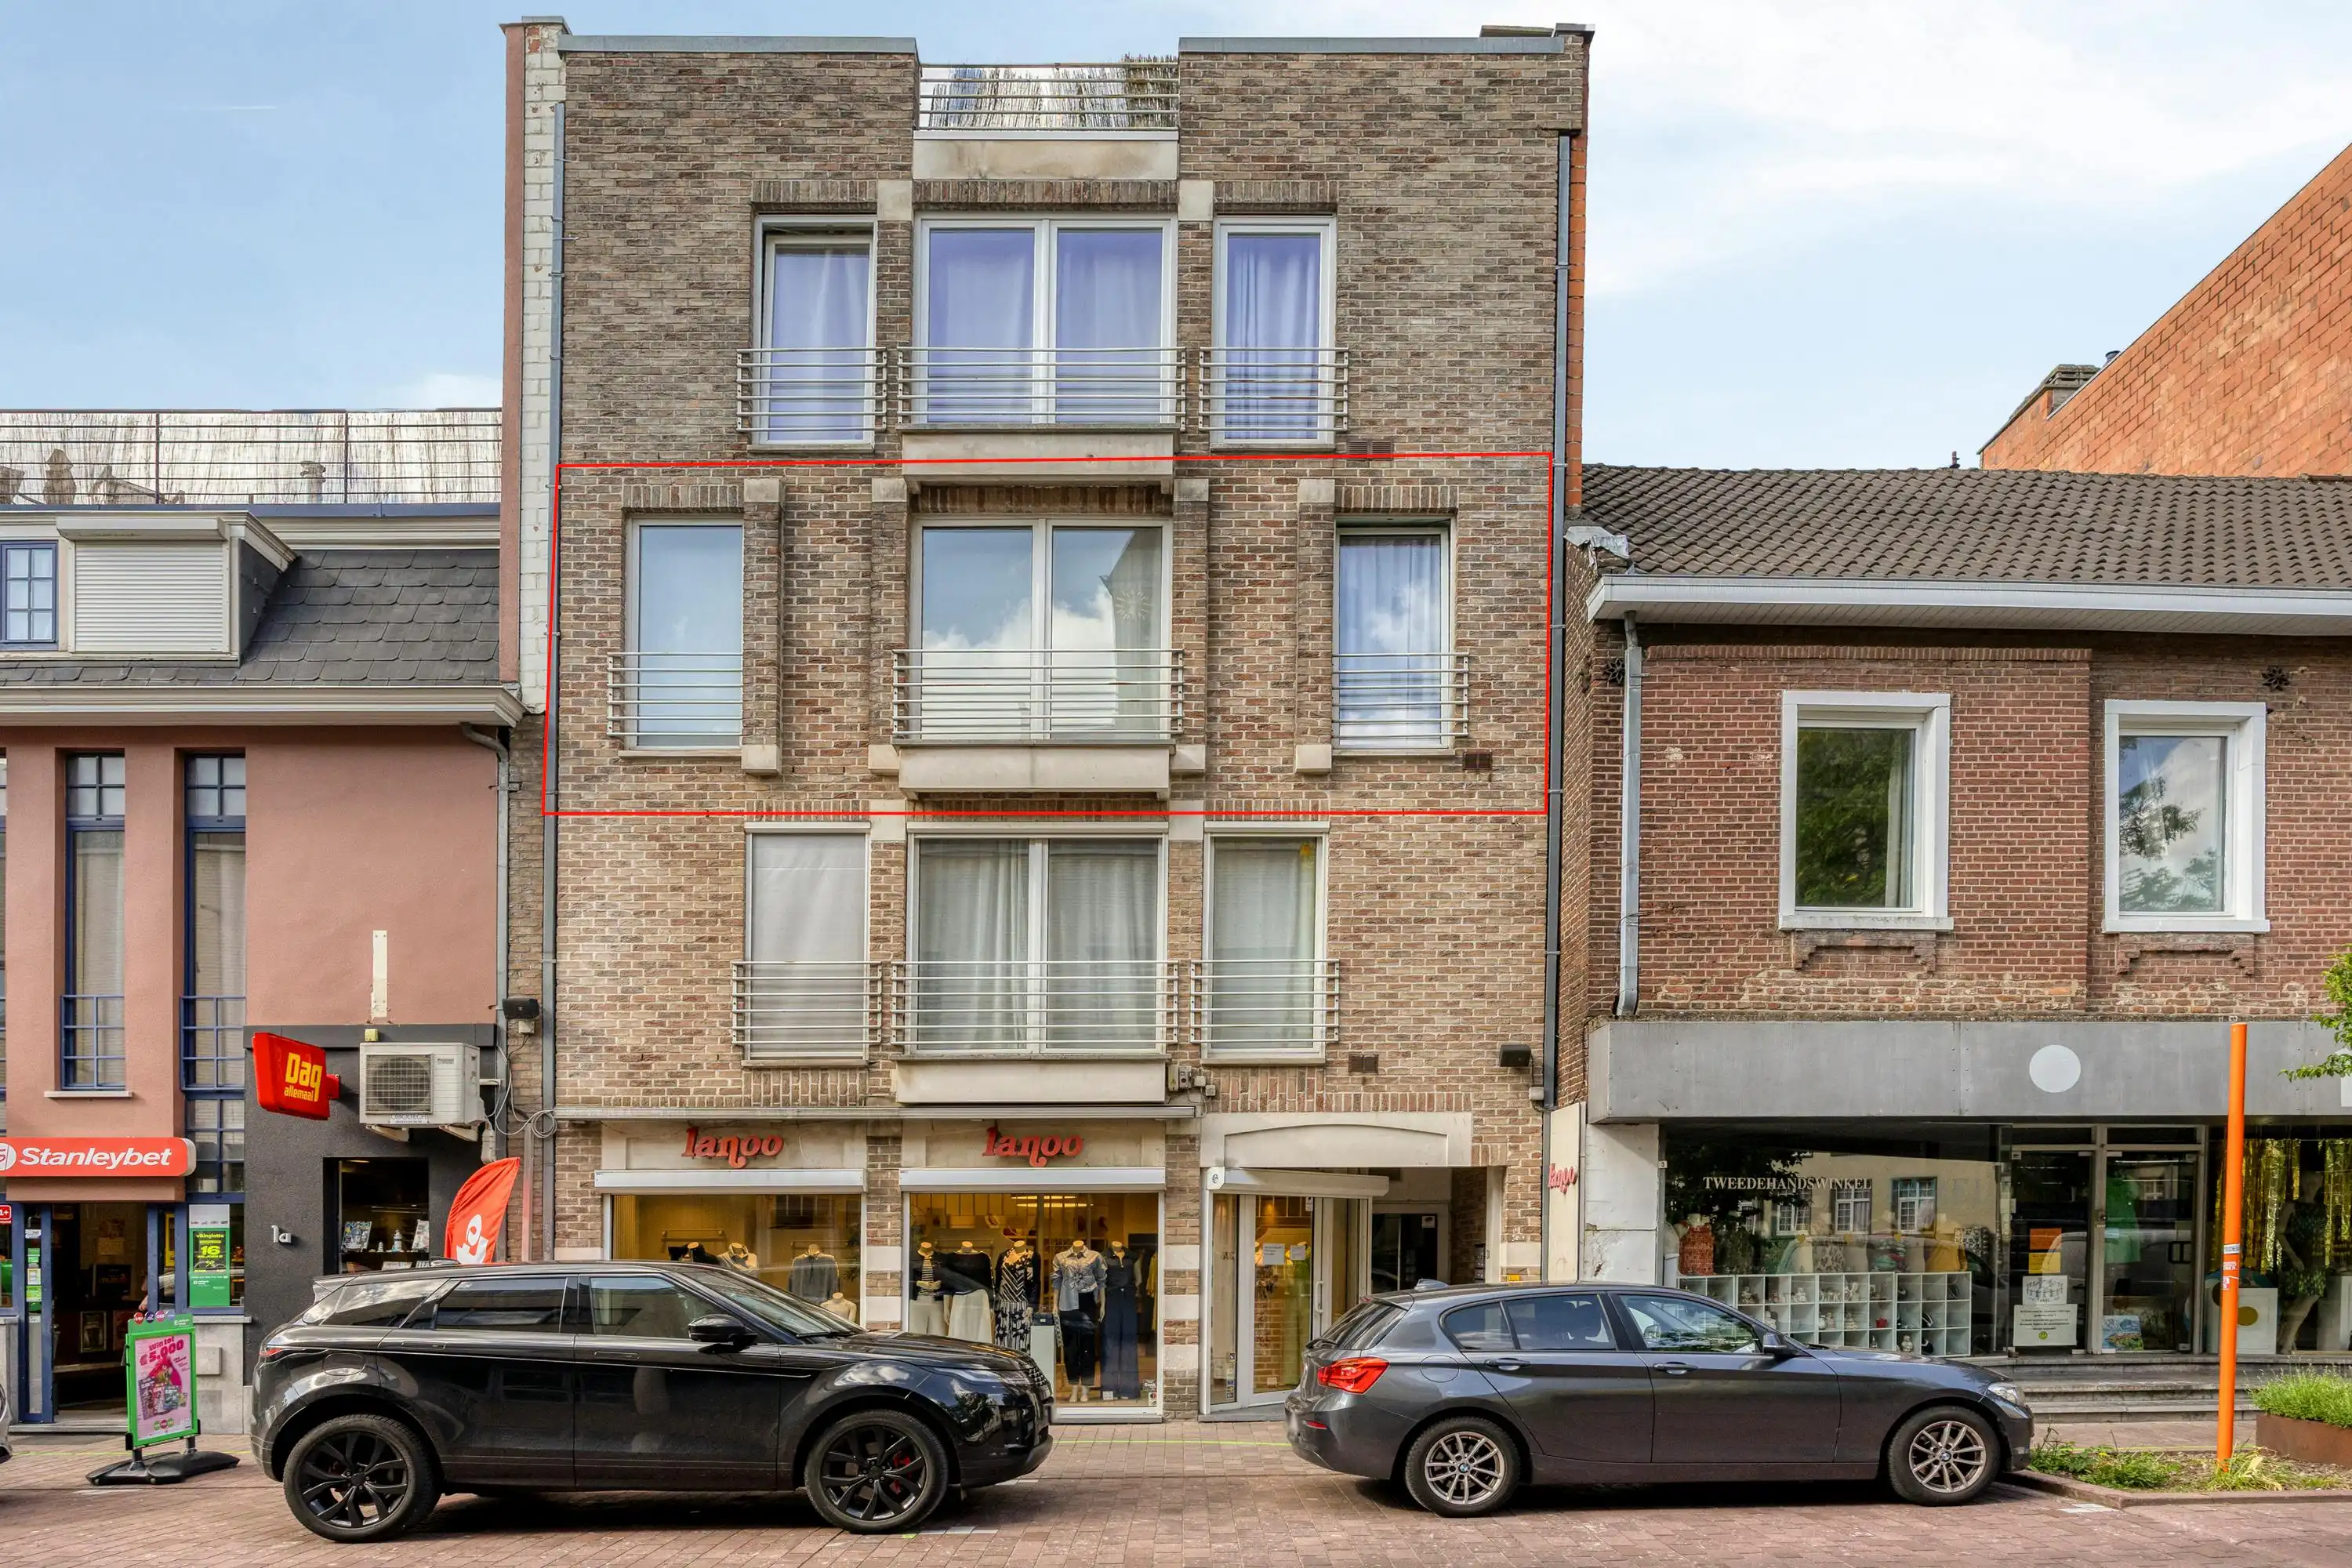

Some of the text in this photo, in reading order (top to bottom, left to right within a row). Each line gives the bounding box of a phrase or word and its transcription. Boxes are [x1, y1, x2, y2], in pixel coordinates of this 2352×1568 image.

[285, 1052, 322, 1102] Dag
[284, 1085, 314, 1101] allemaal
[681, 1127, 784, 1168] lanoo
[982, 1127, 1083, 1167] lanoo
[20, 1147, 172, 1169] Stanleybet
[1703, 1176, 1872, 1190] TWEEDEHANDSWINKEL
[271, 1225, 292, 1243] 1a
[201, 1245, 220, 1255] 16
[149, 1336, 175, 1351] Win tot
